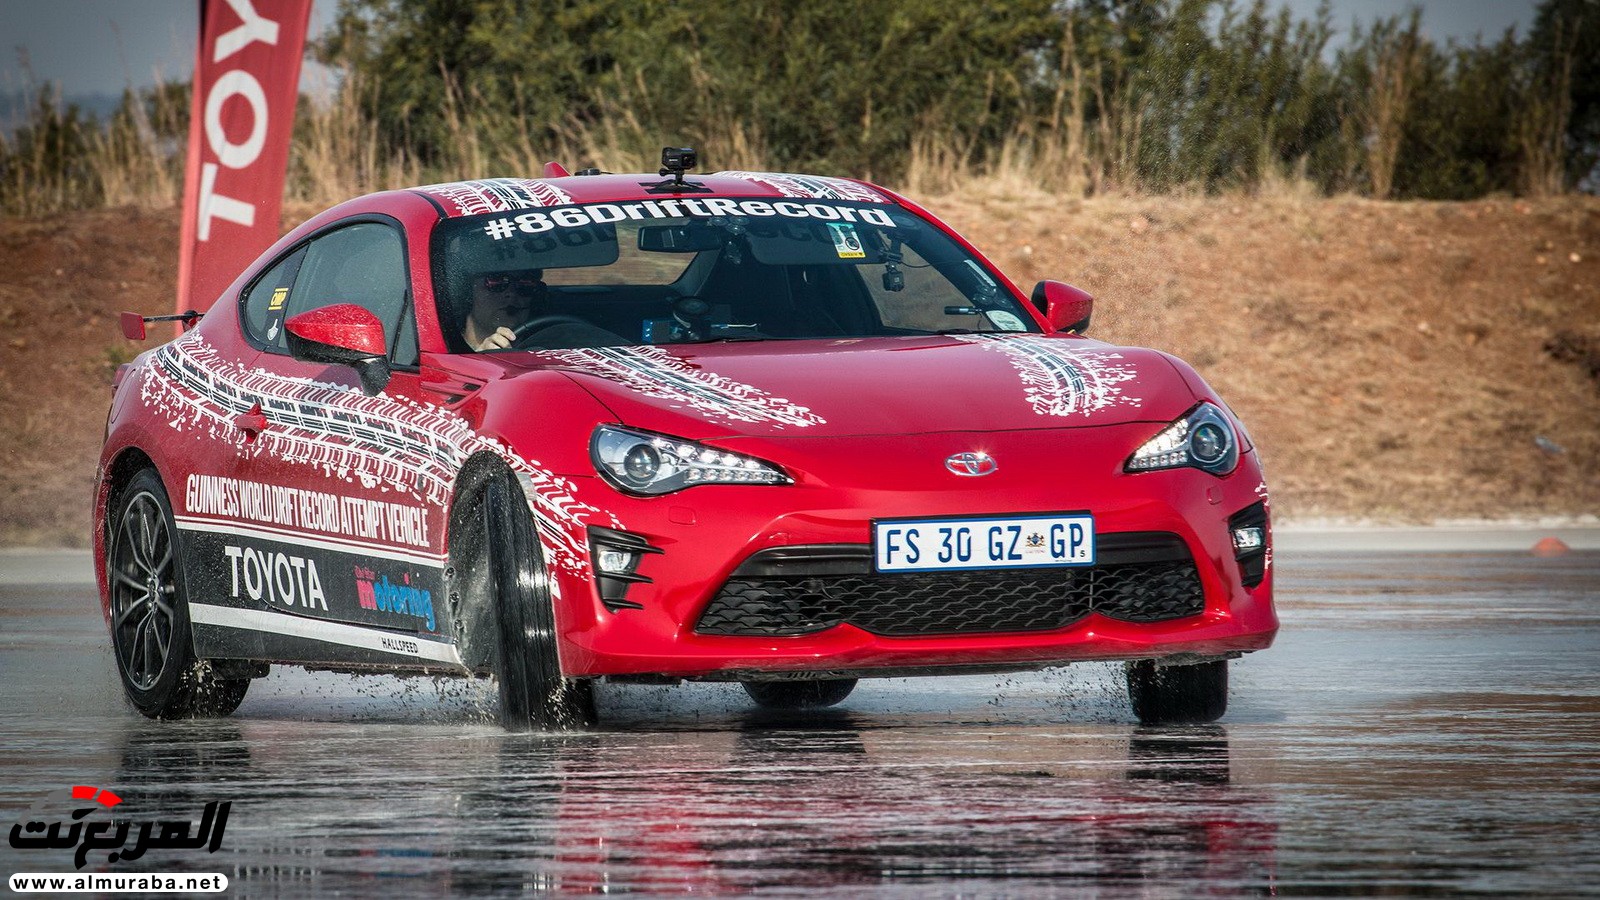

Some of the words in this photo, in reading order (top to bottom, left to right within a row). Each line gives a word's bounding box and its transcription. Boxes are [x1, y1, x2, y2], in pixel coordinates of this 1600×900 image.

[484, 199, 897, 241] #86DriftRecord
[186, 474, 240, 518] GUINNESS
[239, 480, 273, 523] WORLD
[271, 485, 299, 527] DRIFT
[299, 489, 340, 533] RECORD
[340, 496, 386, 540] ATTEMPT
[385, 503, 430, 547] VEHICLE
[886, 529, 920, 564] FS
[938, 527, 972, 563] 30
[988, 526, 1022, 561] GZ
[1051, 523, 1084, 558] GP
[224, 546, 329, 612] TOYOTA
[356, 572, 436, 632] motoring
[381, 637, 418, 654] HALLSPEED
